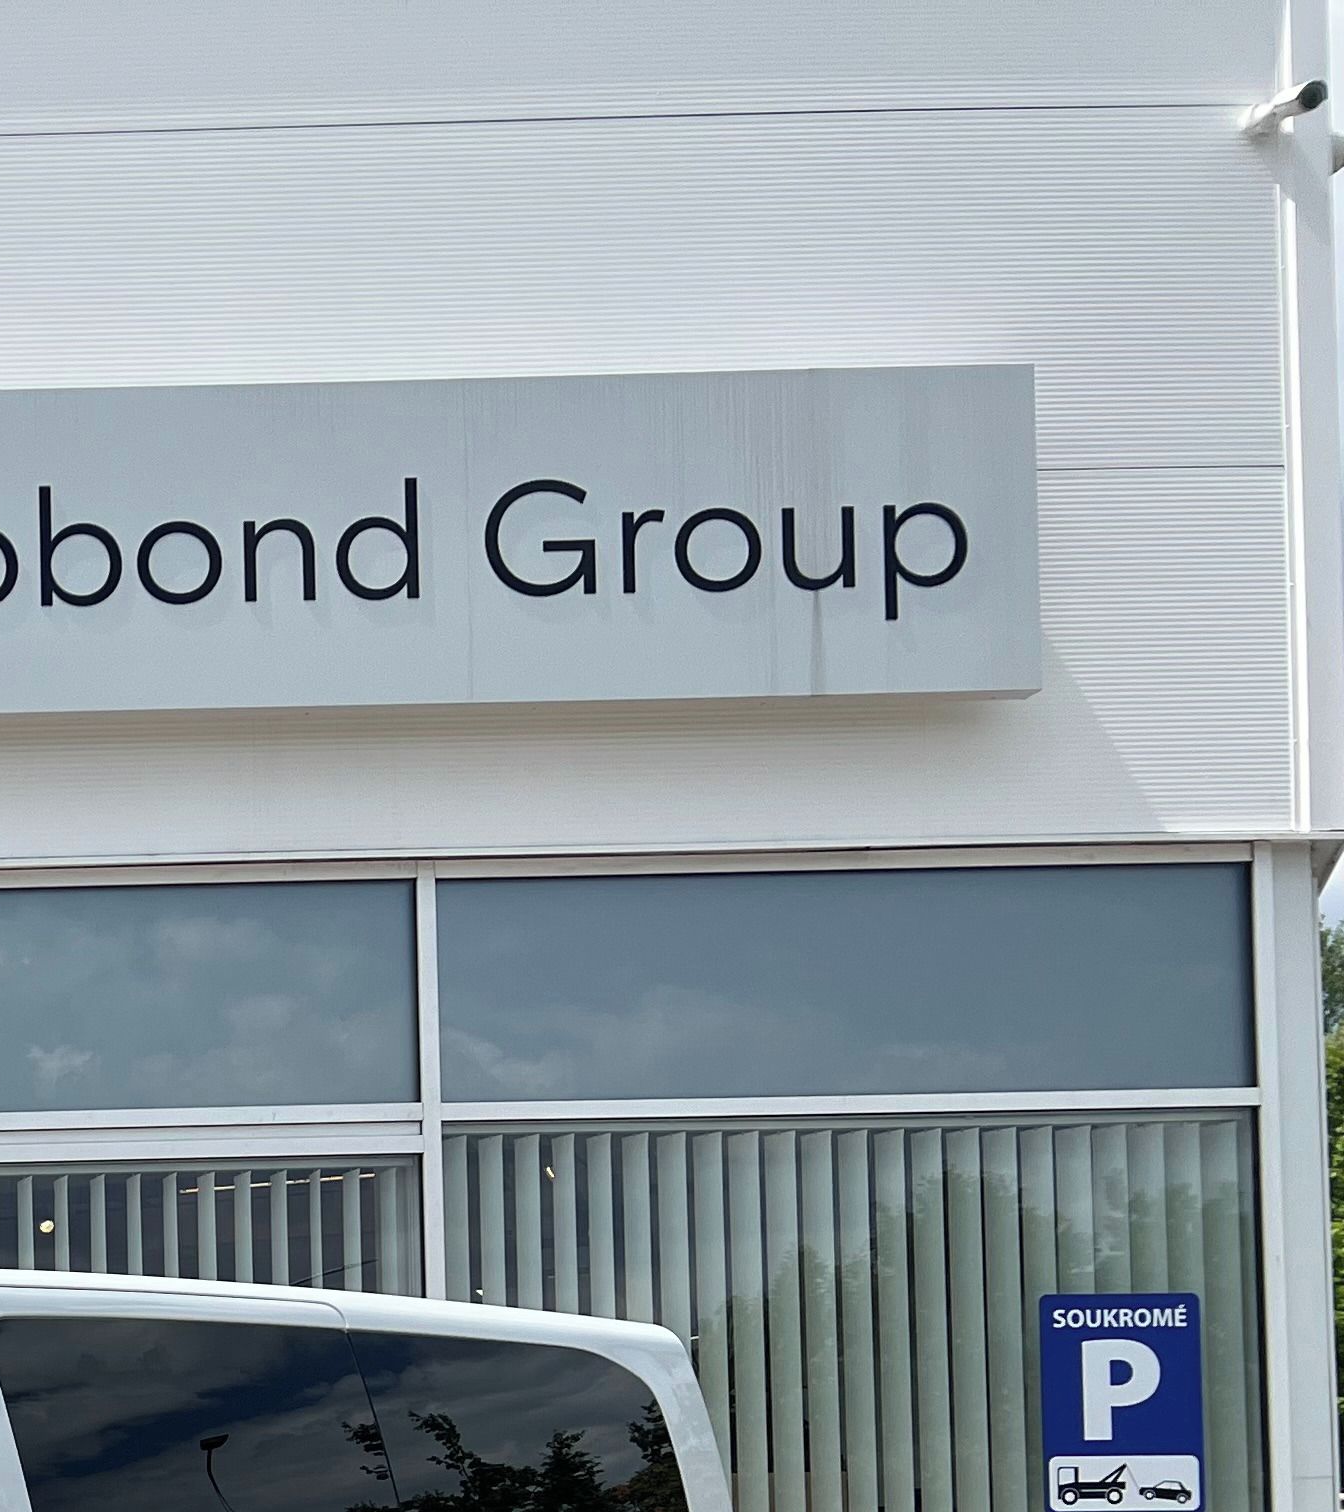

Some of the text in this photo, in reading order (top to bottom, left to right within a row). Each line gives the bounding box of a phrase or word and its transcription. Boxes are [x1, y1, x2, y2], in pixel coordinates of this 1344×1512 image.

[484, 478, 969, 620] Group
[1052, 1304, 1188, 1329] SOUKROMÉ
[1081, 1338, 1161, 1441] P
